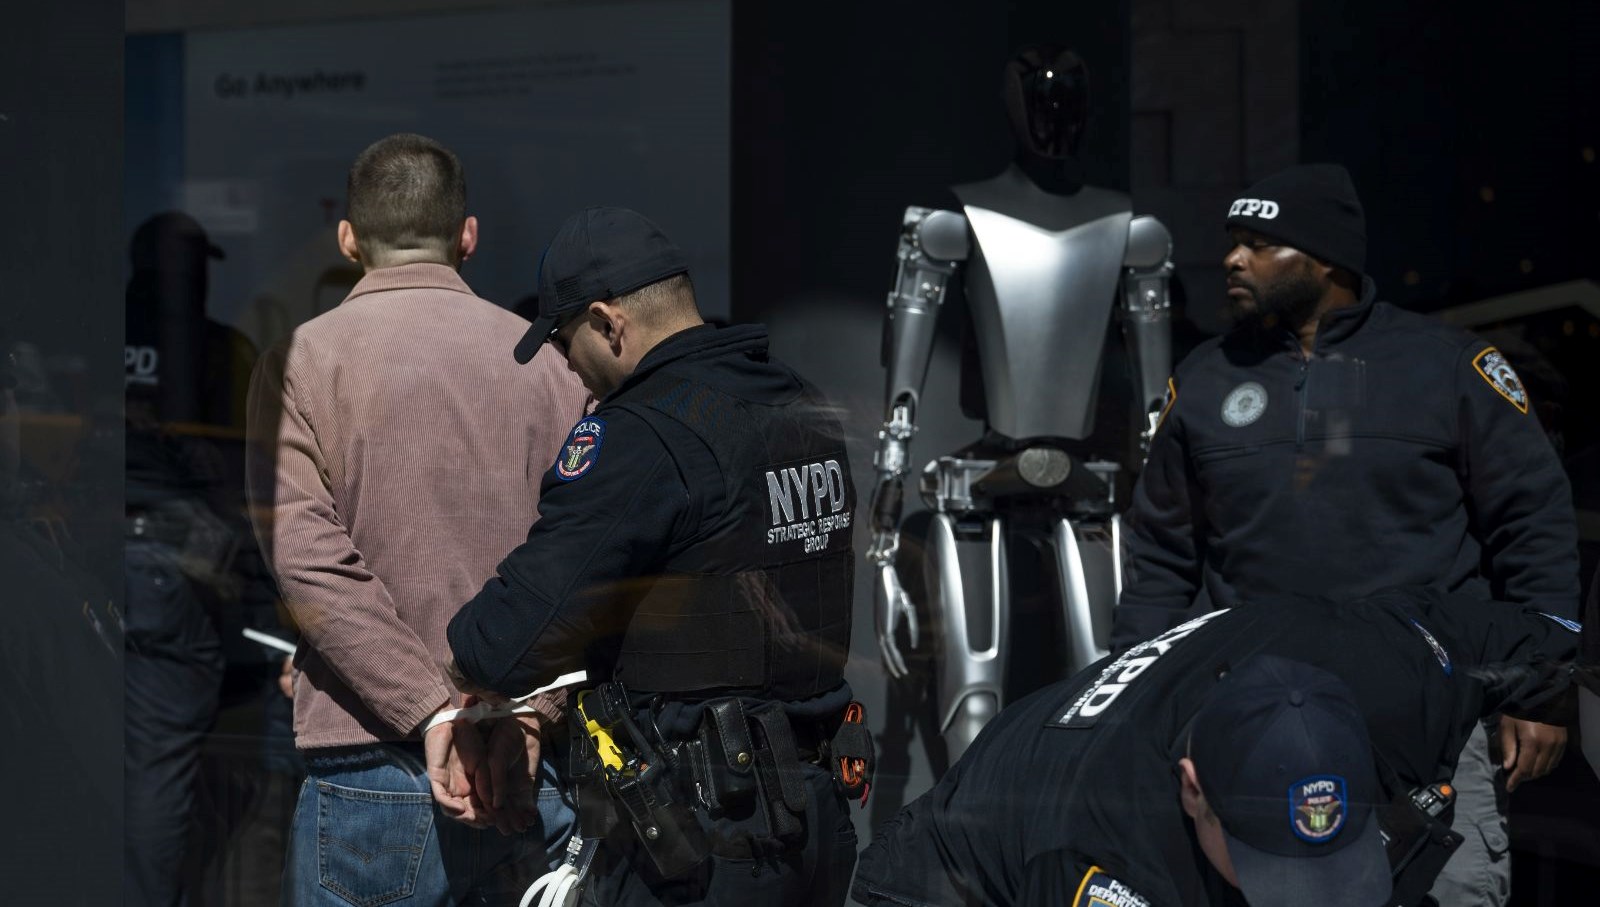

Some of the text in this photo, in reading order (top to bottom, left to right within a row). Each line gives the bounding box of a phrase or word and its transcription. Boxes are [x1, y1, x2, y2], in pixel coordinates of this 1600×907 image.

[214, 69, 367, 99] Go Anywhere
[574, 421, 602, 438] POLICE
[766, 459, 846, 526] NYPD
[767, 512, 851, 545] STRATEGIC RESPONSE
[804, 533, 830, 554] GROUP
[1303, 780, 1336, 797] NYPD
